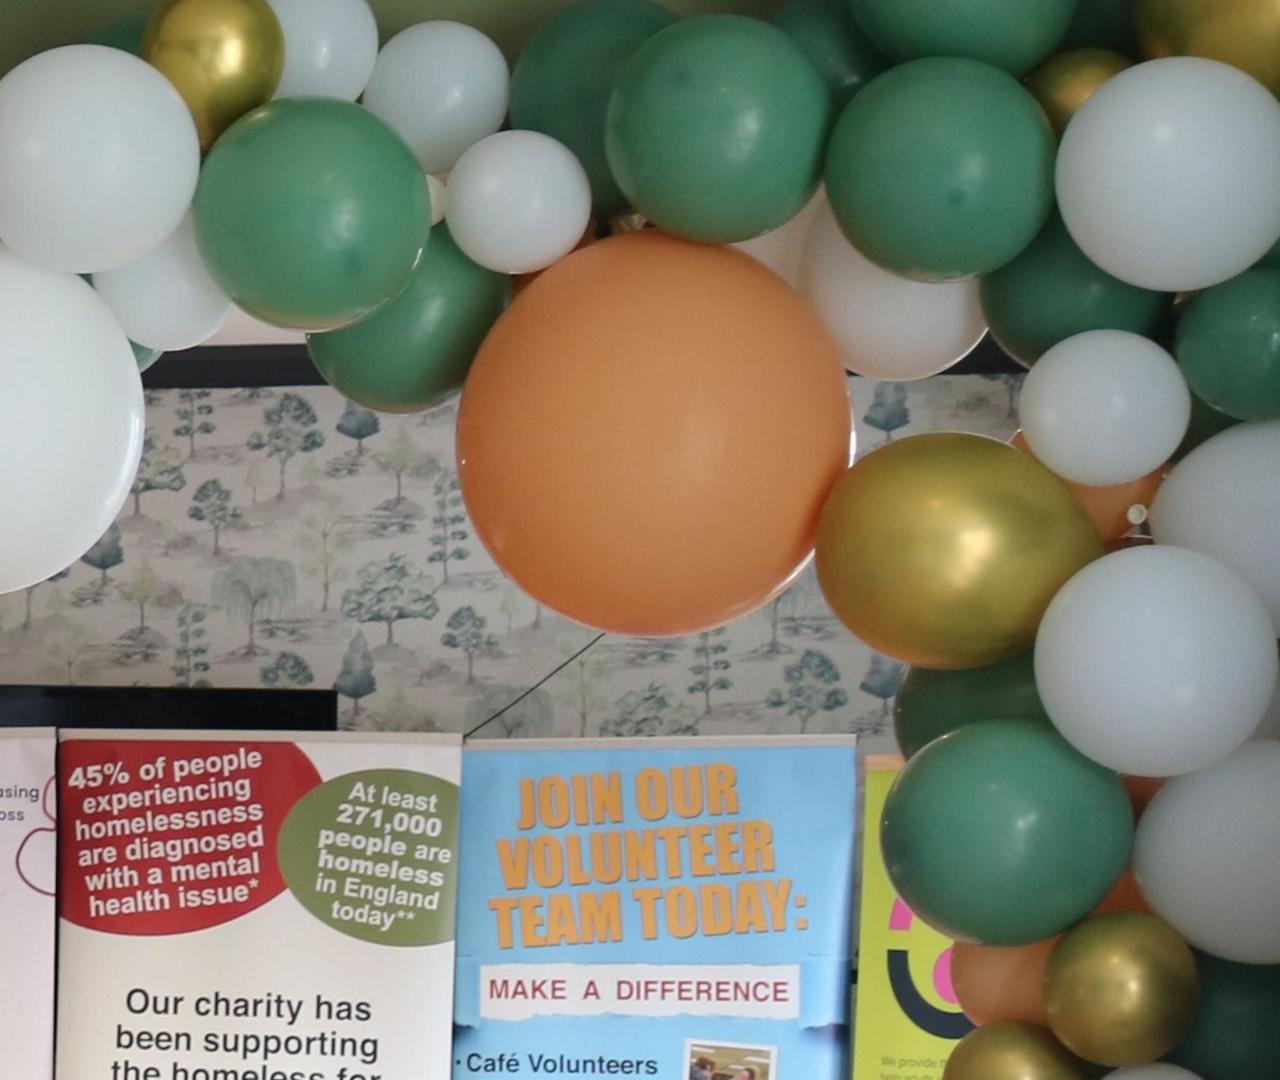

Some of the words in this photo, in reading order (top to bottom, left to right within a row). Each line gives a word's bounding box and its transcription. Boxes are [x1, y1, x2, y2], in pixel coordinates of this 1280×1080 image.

[68, 760, 131, 789] 45%
[140, 756, 168, 781] of
[173, 747, 264, 779] people
[82, 777, 251, 815] experiencing
[348, 781, 377, 802] At
[381, 784, 438, 813] least
[516, 770, 623, 830] JOIN
[635, 762, 739, 822] OUR
[76, 804, 264, 841] homelessness
[336, 804, 443, 838] 271,000
[78, 845, 118, 867] are
[125, 826, 265, 865] diagnosed
[317, 827, 406, 858] people
[414, 842, 452, 865] are
[495, 819, 775, 890] VOLUNTEER
[85, 869, 140, 892] with
[147, 868, 163, 885] a
[171, 852, 260, 882] mental
[318, 849, 444, 887] homeless
[89, 889, 171, 917] health
[315, 873, 337, 894] in
[344, 877, 440, 912] England
[488, 889, 623, 949] TEAM
[634, 878, 809, 940] TODAY:
[126, 988, 184, 1016] Our
[194, 992, 303, 1025] charity
[315, 994, 372, 1021] has
[489, 979, 567, 1000] MAKE
[582, 980, 600, 1000] A
[616, 980, 789, 1002] DIFFERENCE
[115, 1024, 192, 1052] been
[203, 1029, 380, 1065] supporting
[466, 1052, 521, 1074] Café
[528, 1053, 659, 1075] Volunteers
